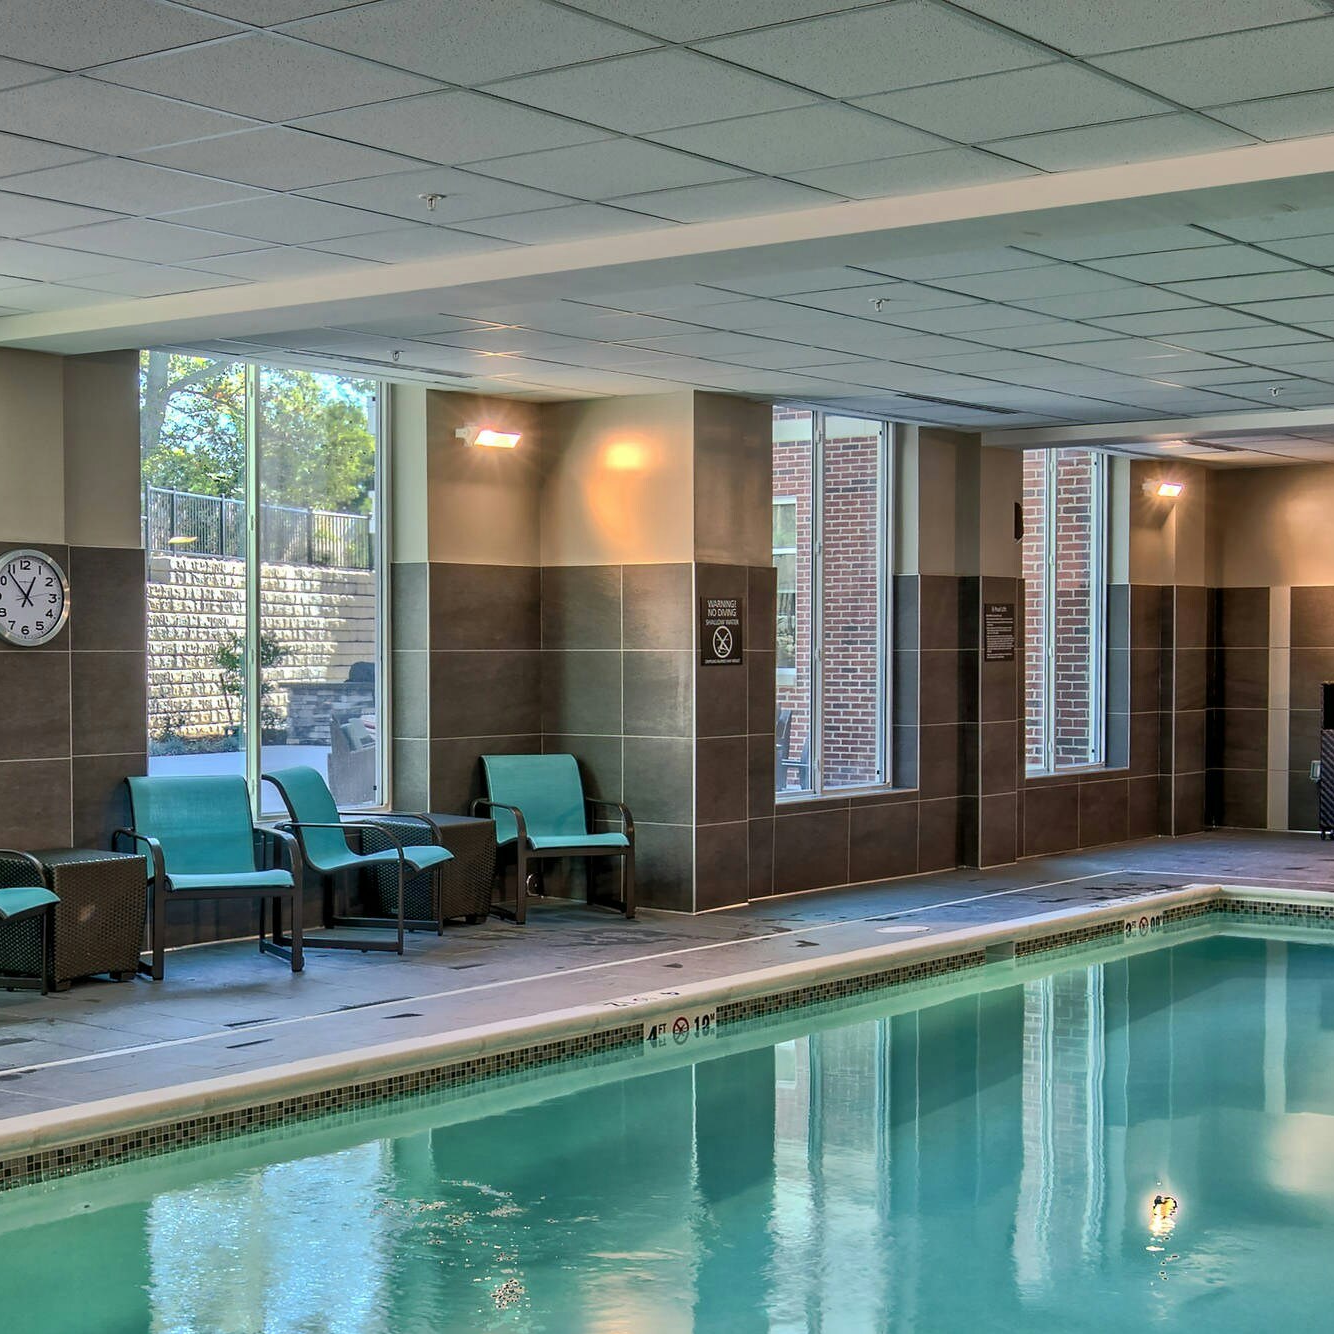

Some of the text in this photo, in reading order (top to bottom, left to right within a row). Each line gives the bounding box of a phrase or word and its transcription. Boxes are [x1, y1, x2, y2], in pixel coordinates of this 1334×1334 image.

[20, 560, 31, 570] 12
[45, 577, 54, 587] 2
[48, 593, 58, 603] 3
[707, 600, 737, 608] WARNING!
[45, 609, 54, 618] 4
[707, 608, 737, 617] NO DIVING
[8, 620, 16, 630] 7
[35, 621, 44, 631] 5
[21, 626, 30, 635] 6
